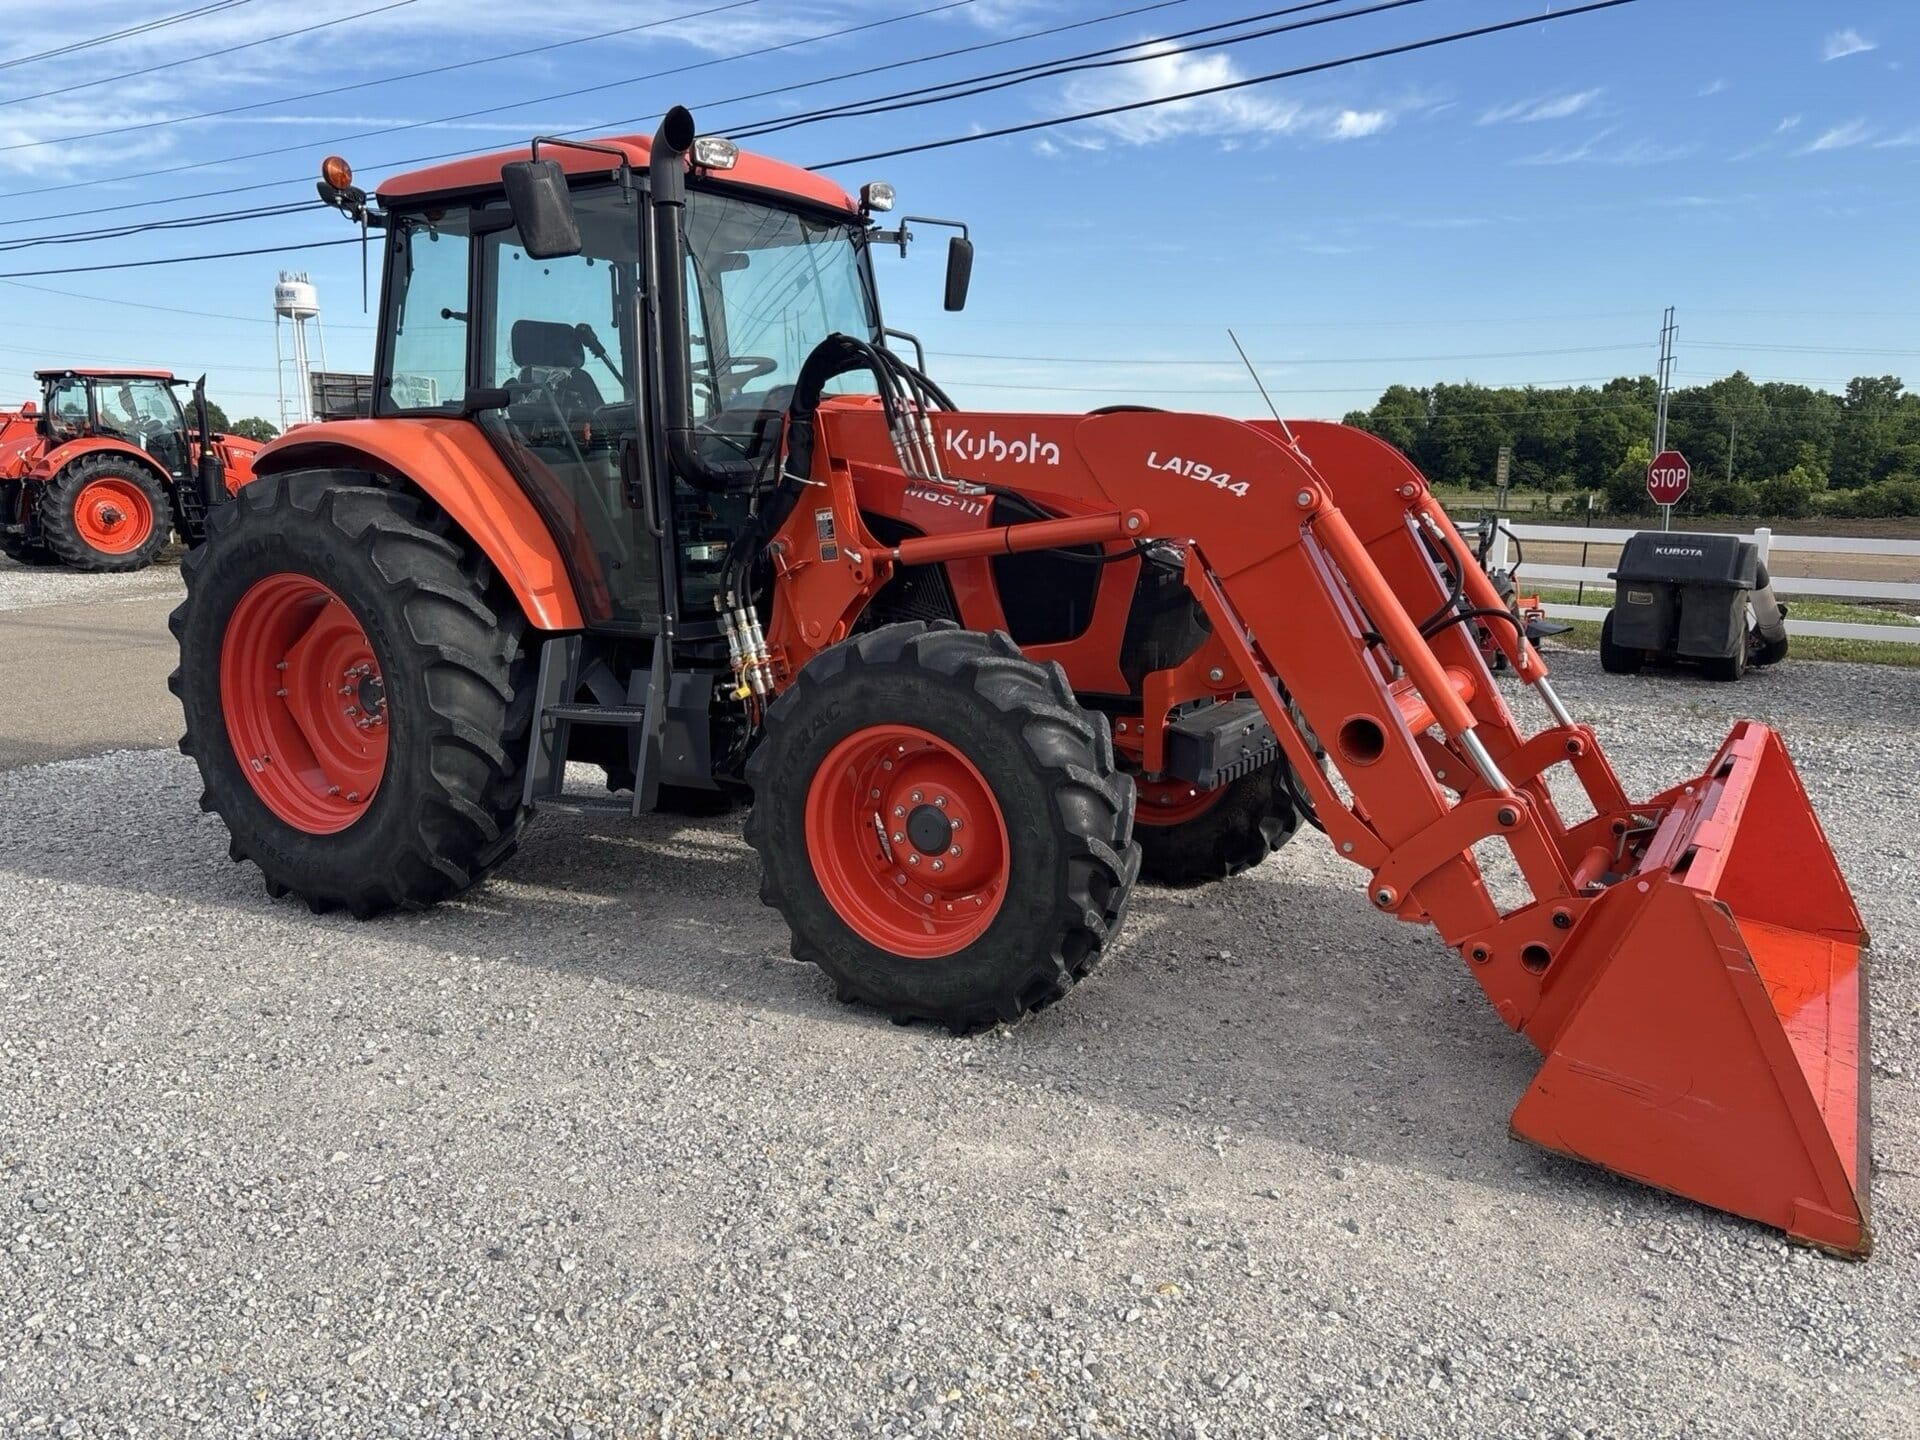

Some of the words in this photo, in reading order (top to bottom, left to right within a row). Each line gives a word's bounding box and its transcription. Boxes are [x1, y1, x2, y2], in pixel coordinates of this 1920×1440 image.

[945, 428, 1060, 465] Kubota
[1146, 451, 1251, 497] LA1944
[1650, 468, 1687, 488] STOP
[1655, 547, 1703, 557] KUBOTA
